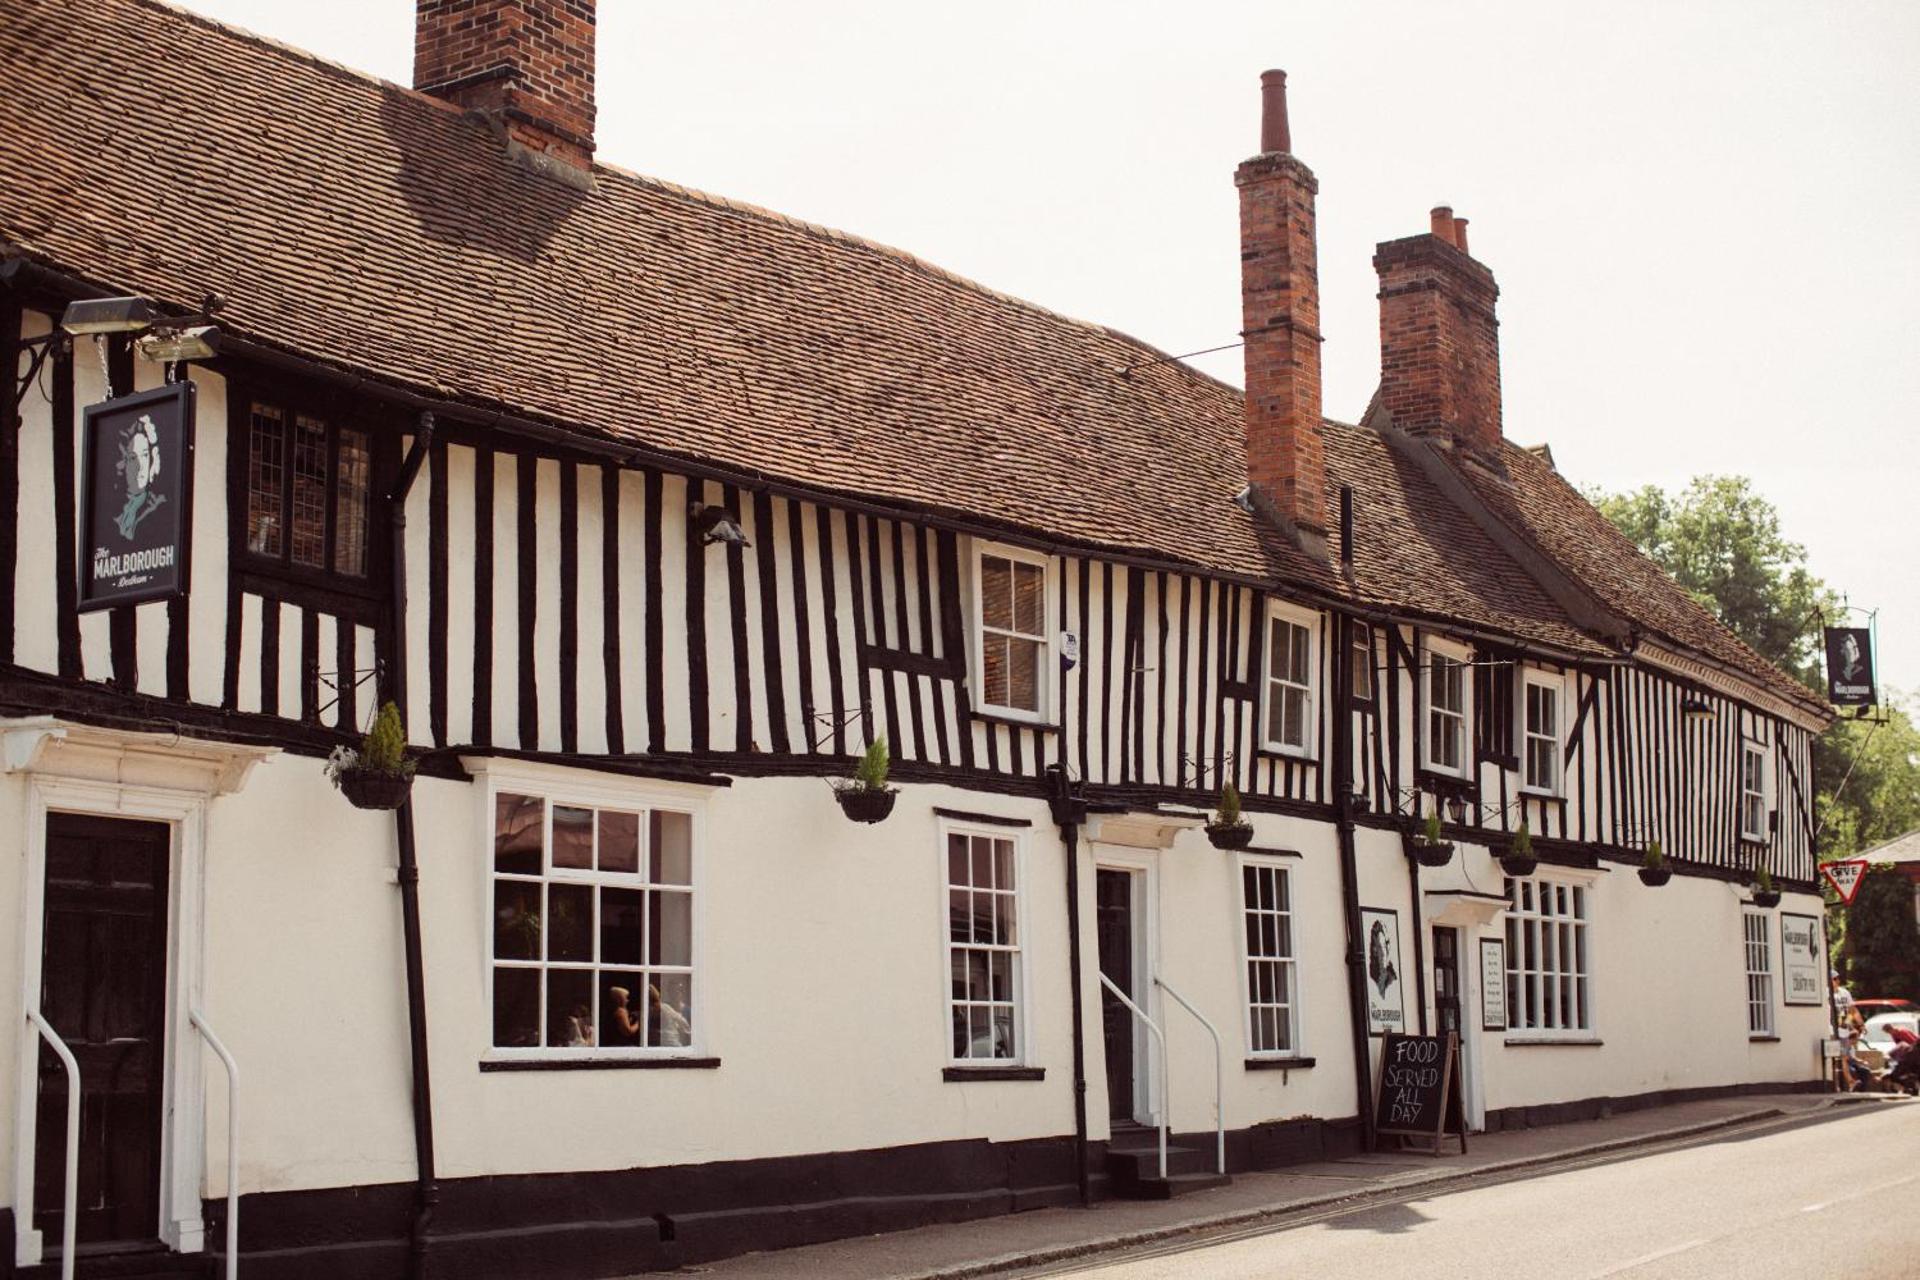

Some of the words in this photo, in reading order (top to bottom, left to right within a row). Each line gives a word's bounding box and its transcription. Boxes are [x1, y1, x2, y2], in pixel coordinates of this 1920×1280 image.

[94, 547, 110, 560] The
[94, 545, 174, 579] MARLBOROUGH
[1831, 867, 1858, 877] GIVE
[1396, 1041, 1437, 1062] FOOD
[1385, 1065, 1437, 1087] SERVED
[1395, 1087, 1422, 1106] ALL
[1391, 1104, 1421, 1123] DAY
